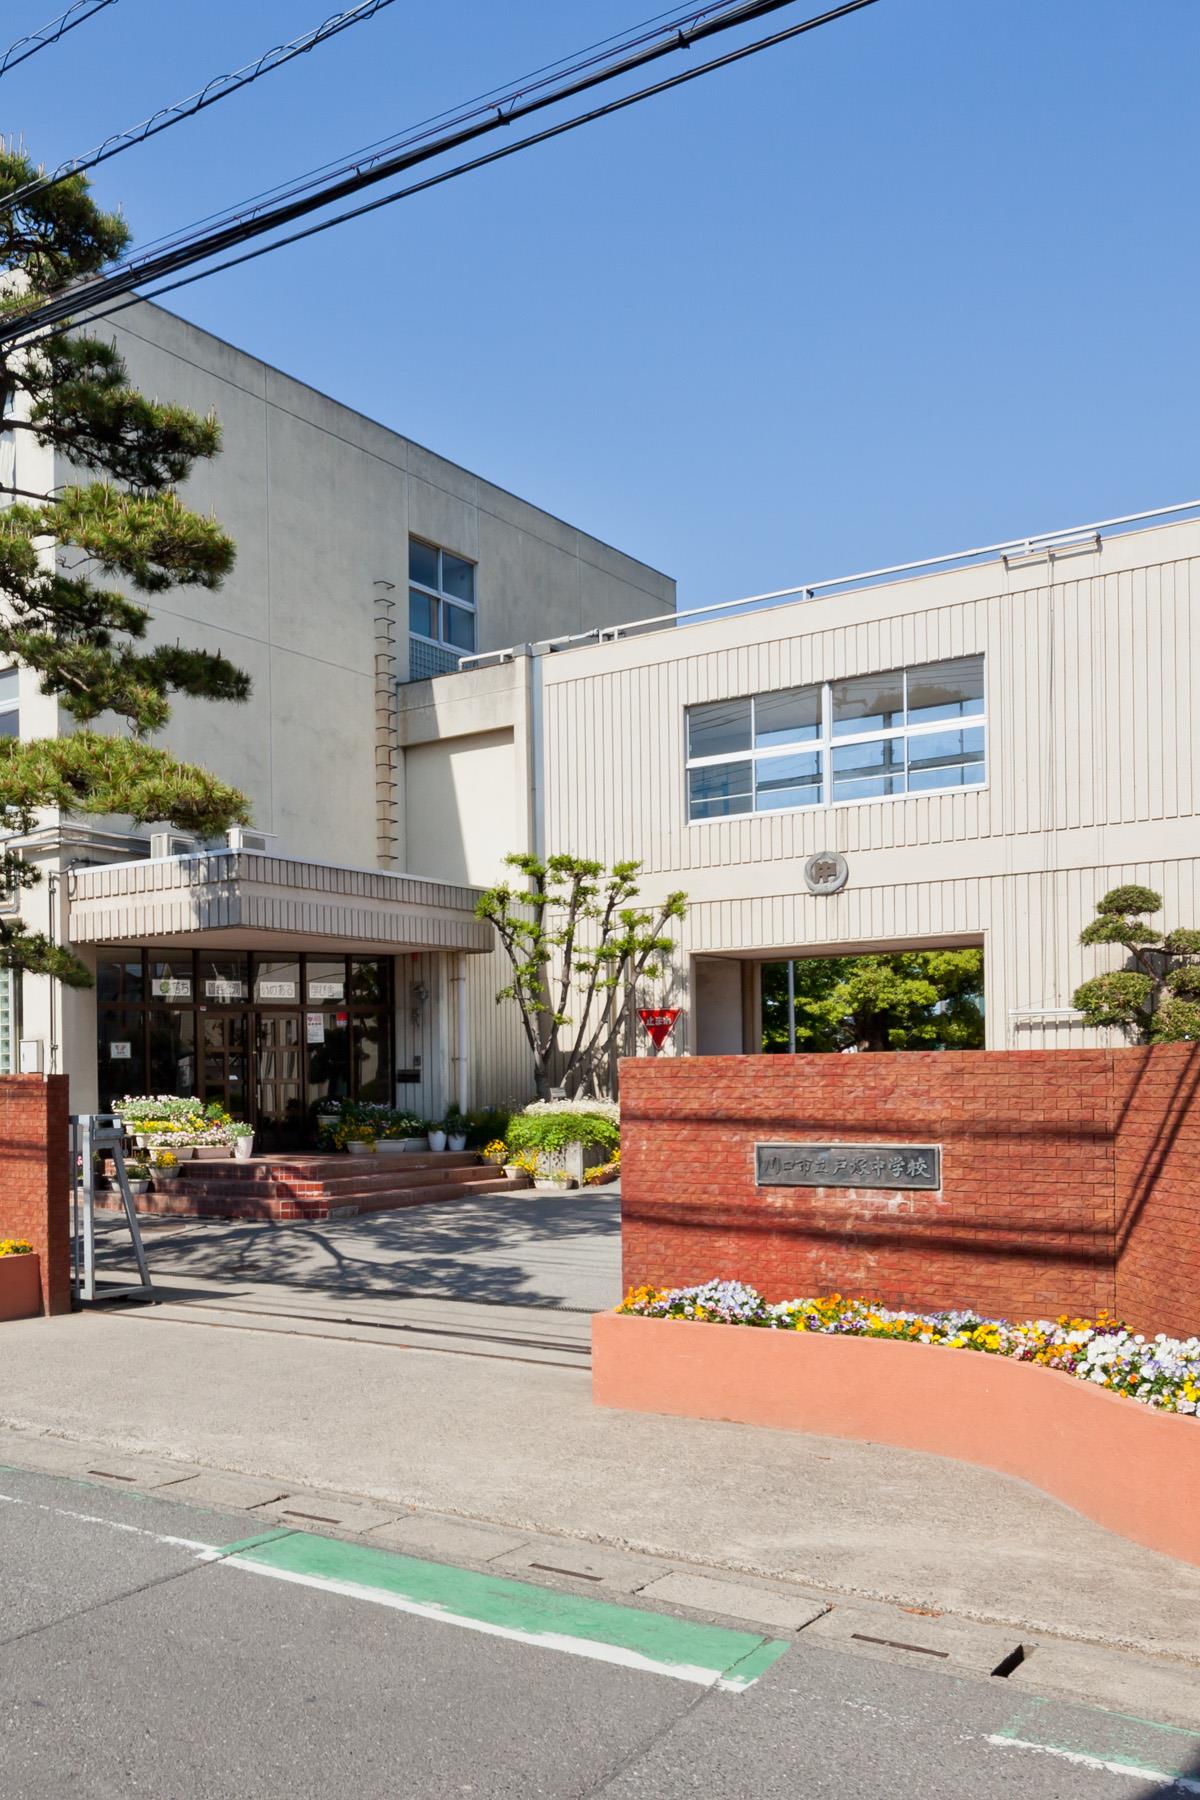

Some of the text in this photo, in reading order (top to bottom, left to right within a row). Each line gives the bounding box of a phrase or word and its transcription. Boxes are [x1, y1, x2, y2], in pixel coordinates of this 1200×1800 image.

[646, 1016, 672, 1026] 止まれ
[763, 1155, 933, 1179] 川口市立戸塚中学校
